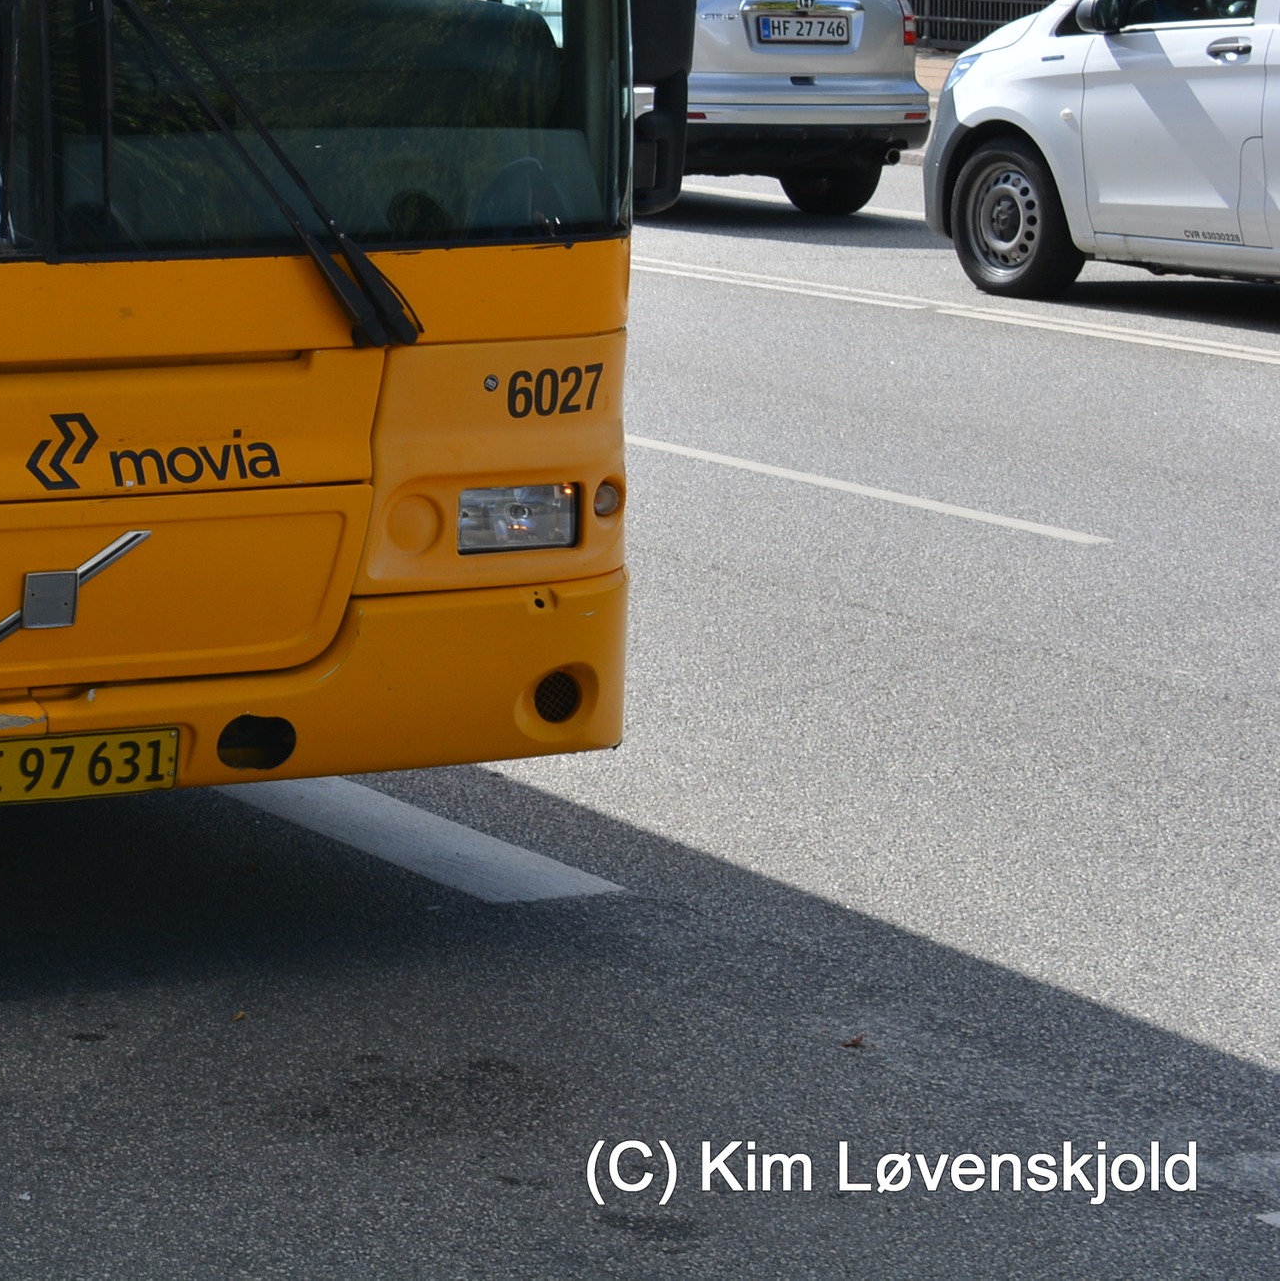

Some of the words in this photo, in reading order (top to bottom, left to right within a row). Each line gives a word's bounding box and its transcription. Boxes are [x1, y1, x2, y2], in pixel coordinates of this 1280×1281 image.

[771, 20, 791, 37] HF
[795, 20, 813, 37] 27
[817, 21, 845, 37] 746
[1184, 229, 1201, 239] CVR
[507, 362, 604, 419] 6027
[109, 429, 281, 488] movia
[19, 745, 75, 793] 97
[89, 739, 165, 787] 631
